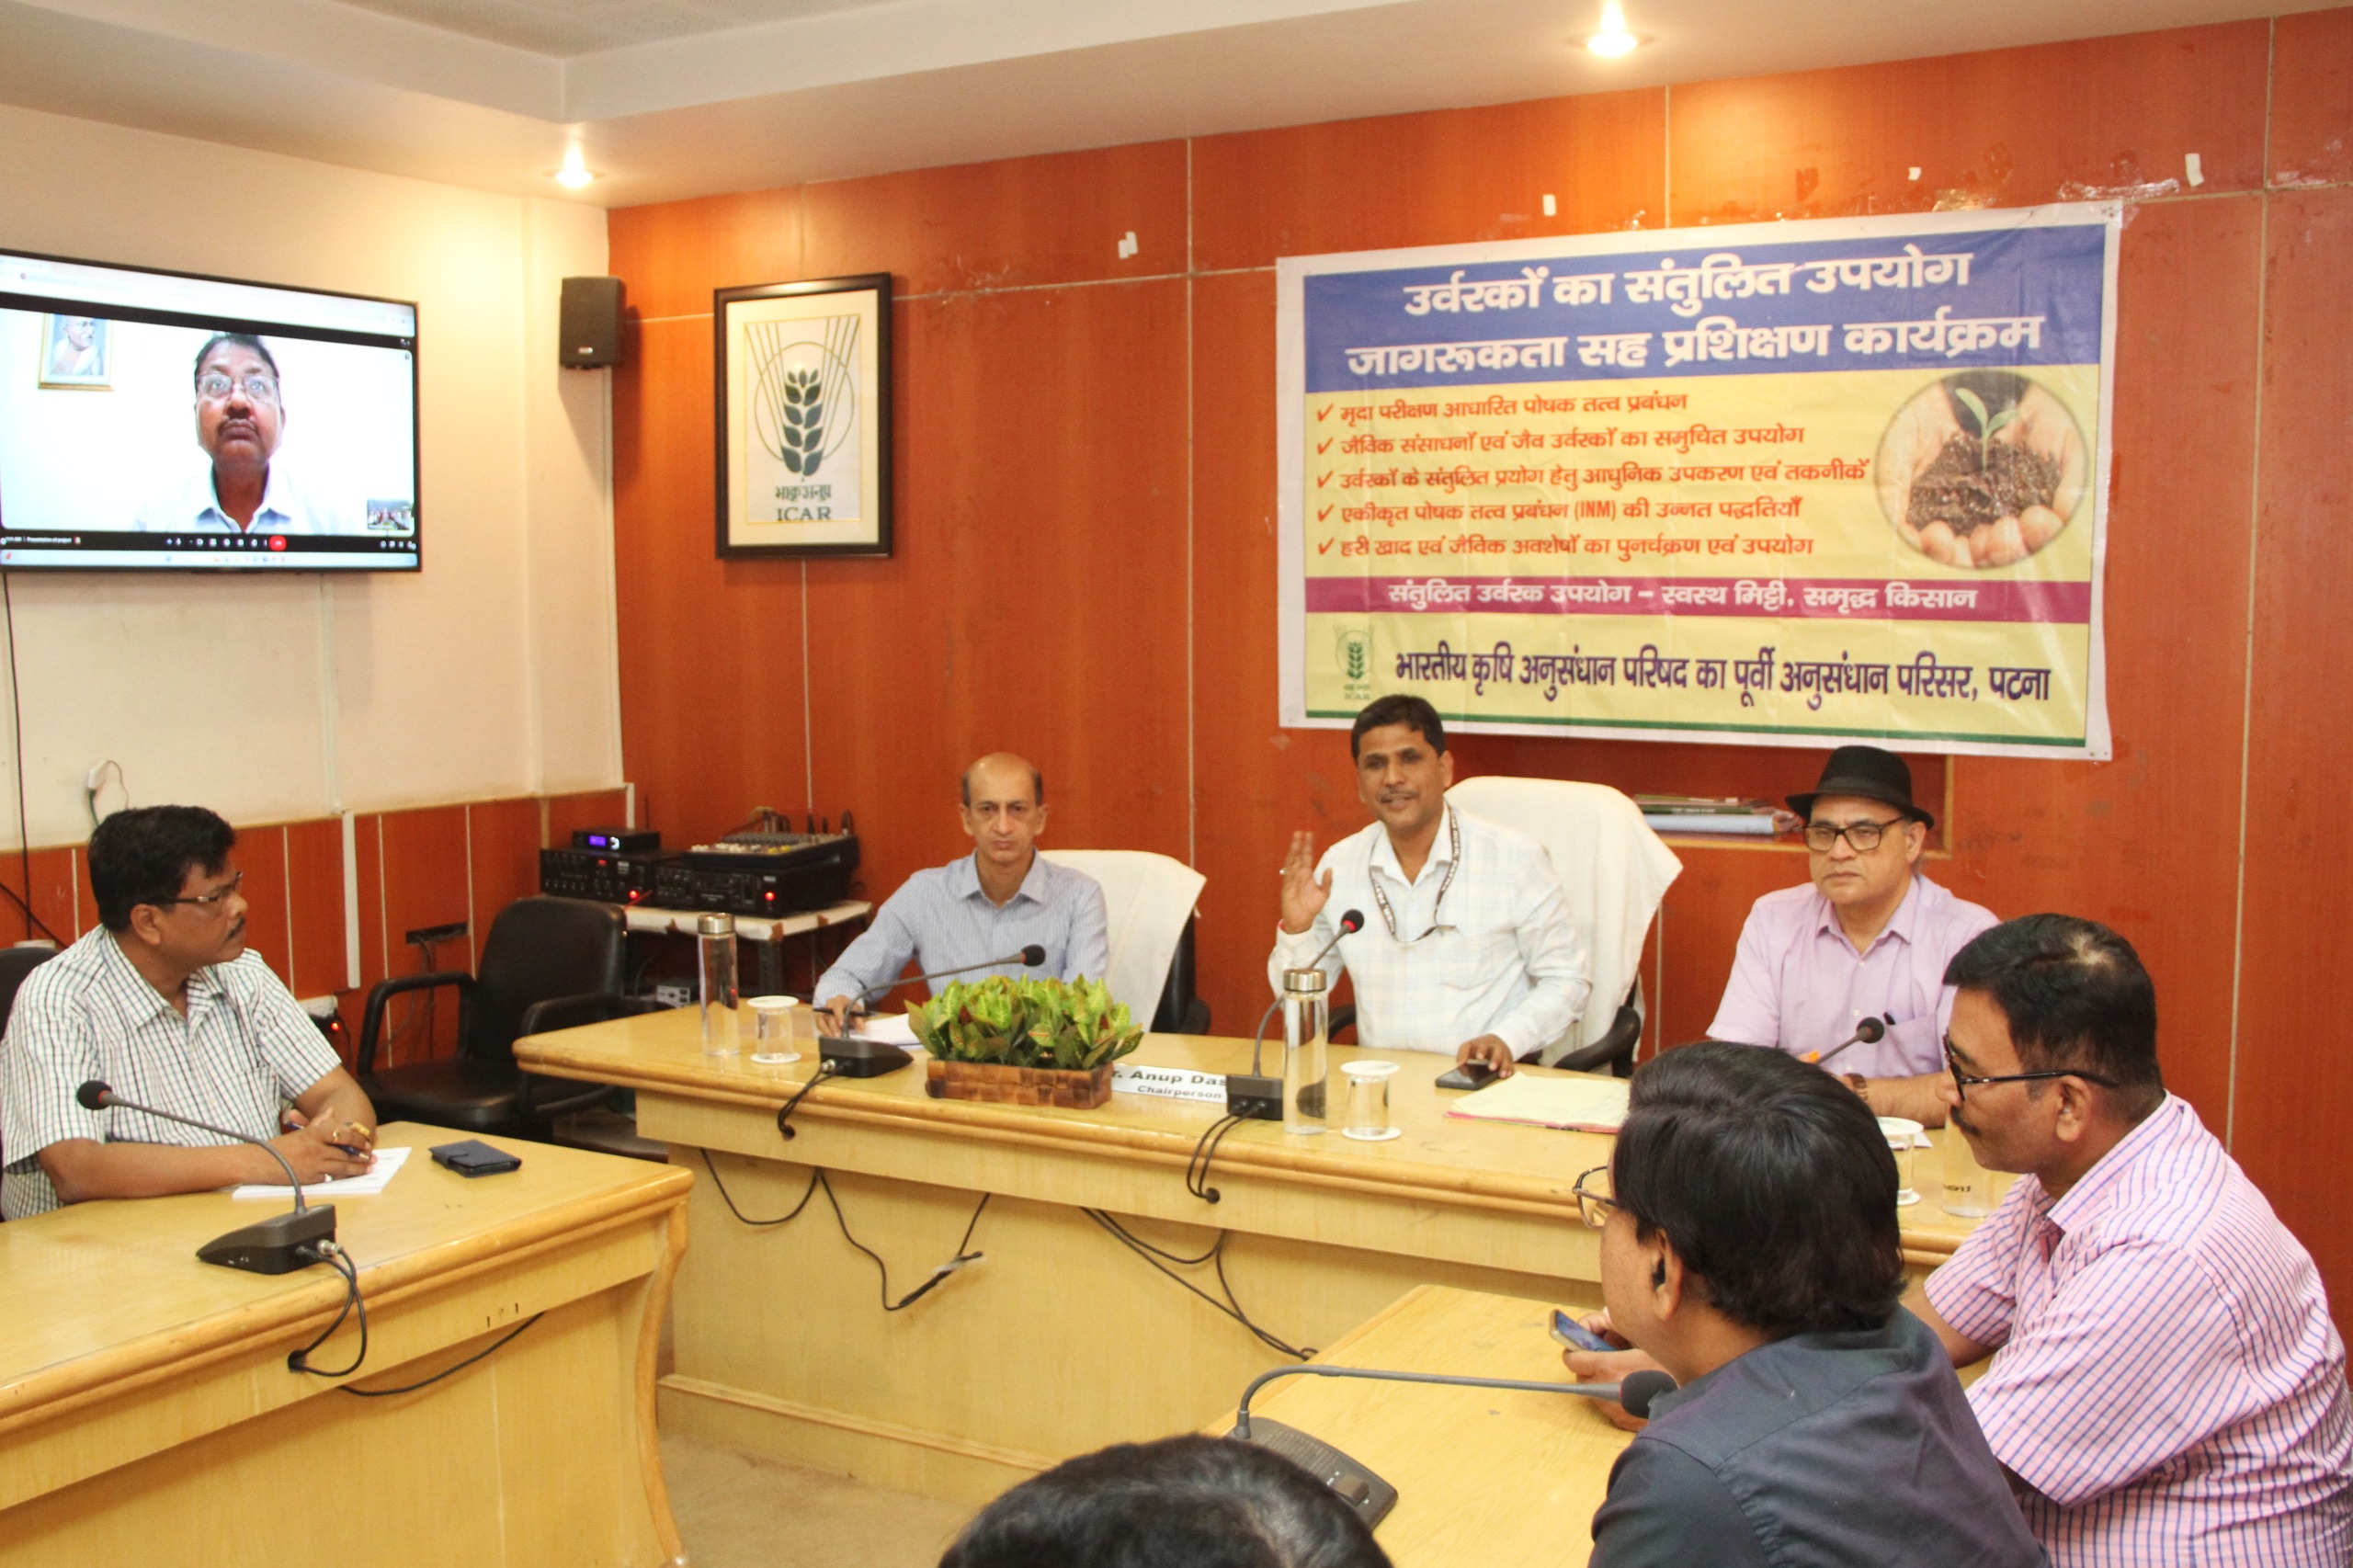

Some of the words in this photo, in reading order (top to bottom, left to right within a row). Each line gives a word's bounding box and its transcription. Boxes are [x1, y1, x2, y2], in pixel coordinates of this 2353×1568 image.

[1404, 267, 1549, 314] उर्वरकों
[1552, 273, 1614, 305] का
[1623, 253, 1794, 316] संतुलित
[1803, 244, 1973, 292] उपयोग
[1345, 337, 1568, 375] जागरूकता
[1577, 333, 1653, 367] सह
[1662, 316, 1832, 366] प्रशिक्षण
[1844, 305, 2045, 356] कार्यक्रम
[1342, 407, 1373, 426] मृदा
[1380, 400, 1438, 419] परीक्षण
[1445, 395, 1517, 417] आधारित
[1524, 396, 1574, 413] पोषक
[1628, 391, 1688, 412] प्रबंधन
[1343, 435, 1393, 454] जैविक
[1402, 432, 1477, 453] संसाधनों
[1480, 431, 1508, 450] एवं
[1513, 430, 1544, 449] जैव
[1552, 427, 1617, 449] उर्वरकों
[1621, 432, 1647, 446] का
[1654, 425, 1726, 450] समुचित
[1735, 424, 1803, 444] उपयोग
[1342, 469, 1397, 488] उर्वरकों
[1403, 471, 1419, 485] के
[1426, 465, 1489, 491] संतुलित
[1495, 466, 1543, 485] प्रयोग
[1551, 466, 1577, 490] हेतु
[1584, 461, 1662, 489] आधुनिक
[1670, 467, 1745, 482] उपकरण
[1751, 460, 1781, 482] एवं
[777, 506, 831, 521] ICAR
[1342, 502, 1408, 527] एकीकृत
[1415, 502, 1463, 519] पोषक
[1513, 500, 1568, 520] प्रबंधन
[1575, 501, 1616, 518] (INM)
[1623, 497, 1650, 517] की
[1657, 503, 1711, 517] उन्नत
[1342, 536, 1370, 557] हरी
[1375, 540, 1412, 555] खाद
[1419, 537, 1446, 555] एवं
[1450, 534, 1506, 553] जैविक
[1513, 534, 1581, 554] अवशेषों
[1585, 540, 1610, 553] का
[1708, 534, 1738, 555] एवं
[1744, 534, 1813, 554] उपयोग
[1390, 579, 1470, 609] संतुलित
[1478, 578, 1544, 602] उर्वरक
[1551, 580, 1631, 603] उपयोग
[1662, 586, 1727, 604] स्वस्थ
[1803, 588, 1878, 614] समृद्ध
[1885, 579, 1979, 608] किसान
[1395, 640, 1468, 681] भारतीय
[1472, 642, 1514, 696] कृषि
[1520, 646, 1616, 701] अनुसंधान
[1623, 645, 1689, 687] परिषद
[1697, 660, 1726, 688] का
[1735, 648, 1775, 706] पूर्वी
[1781, 653, 1890, 710] अनुसंधान
[1897, 652, 1977, 699] परिसर,
[1989, 668, 2051, 699] पटना
[1131, 1071, 1183, 1084] Anup
[1138, 1085, 1222, 1097] Chairperson
